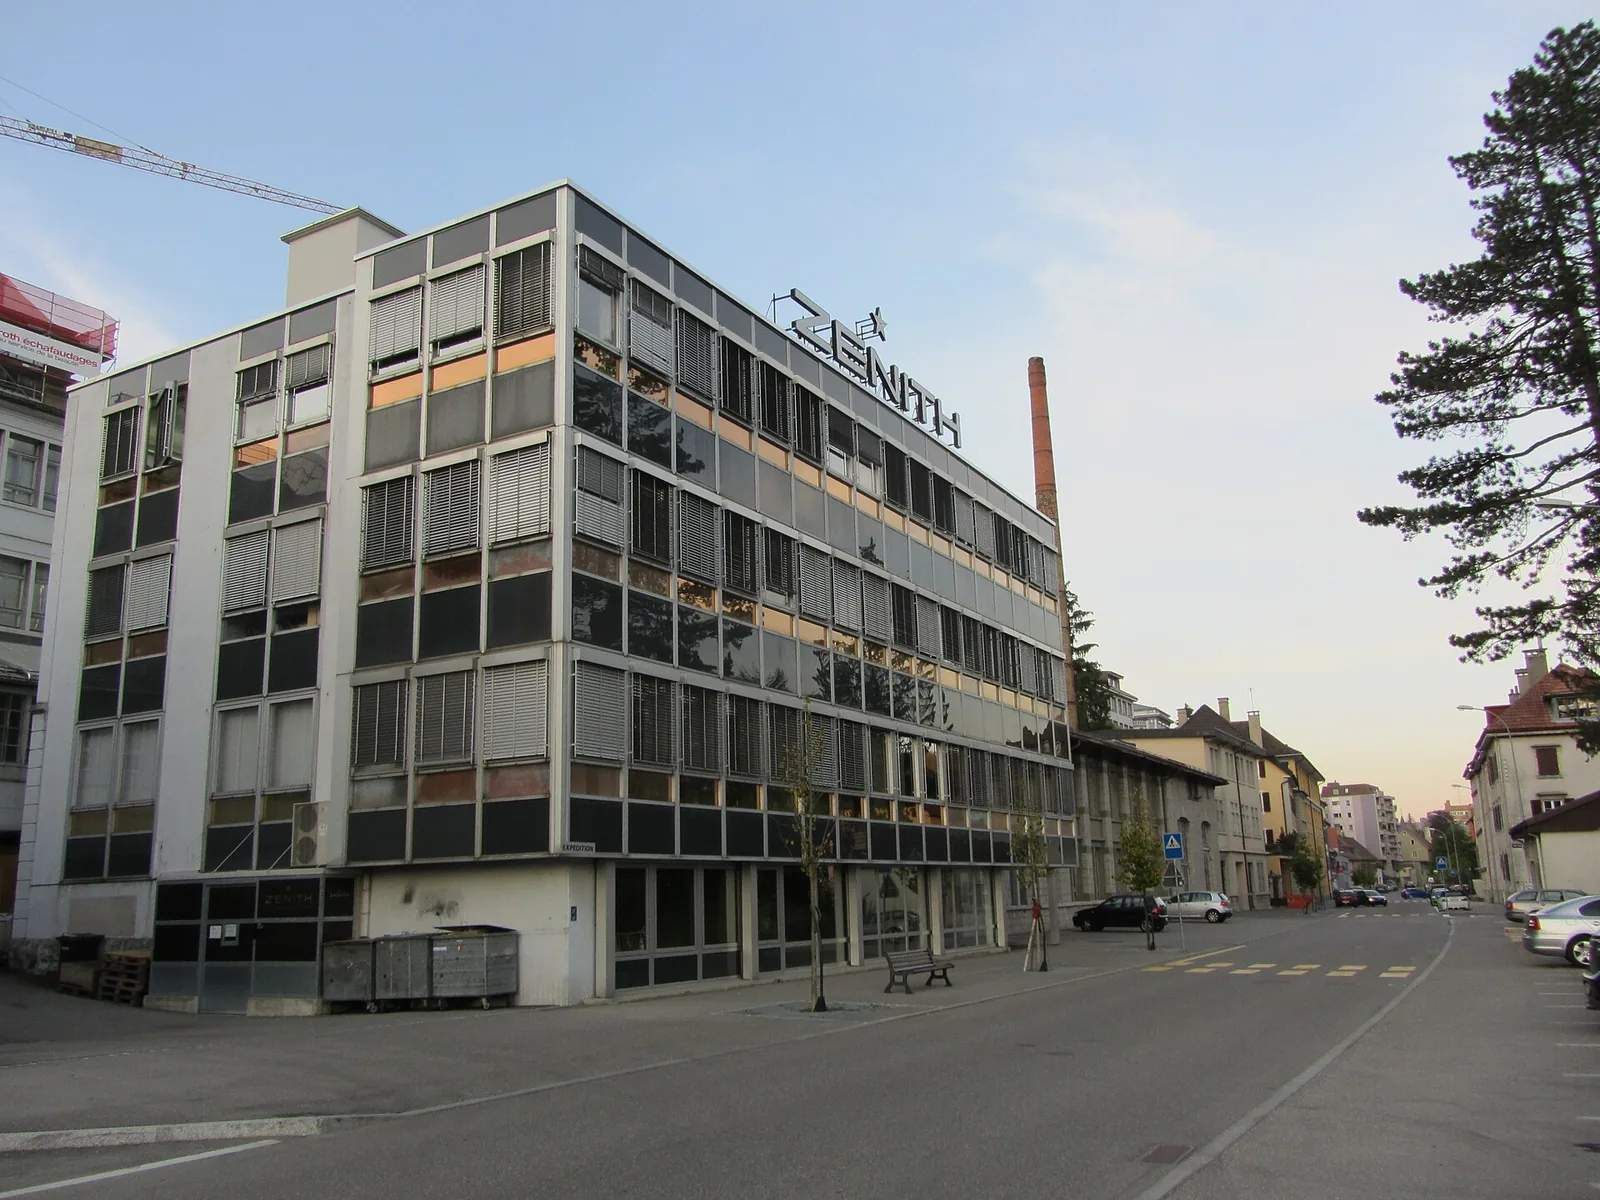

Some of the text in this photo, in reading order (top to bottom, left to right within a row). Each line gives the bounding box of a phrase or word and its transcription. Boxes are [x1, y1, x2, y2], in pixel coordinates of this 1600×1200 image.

[23, 337, 98, 367] échafaudages
[790, 287, 962, 449] ZENITH
[264, 892, 313, 905] ZENITH
